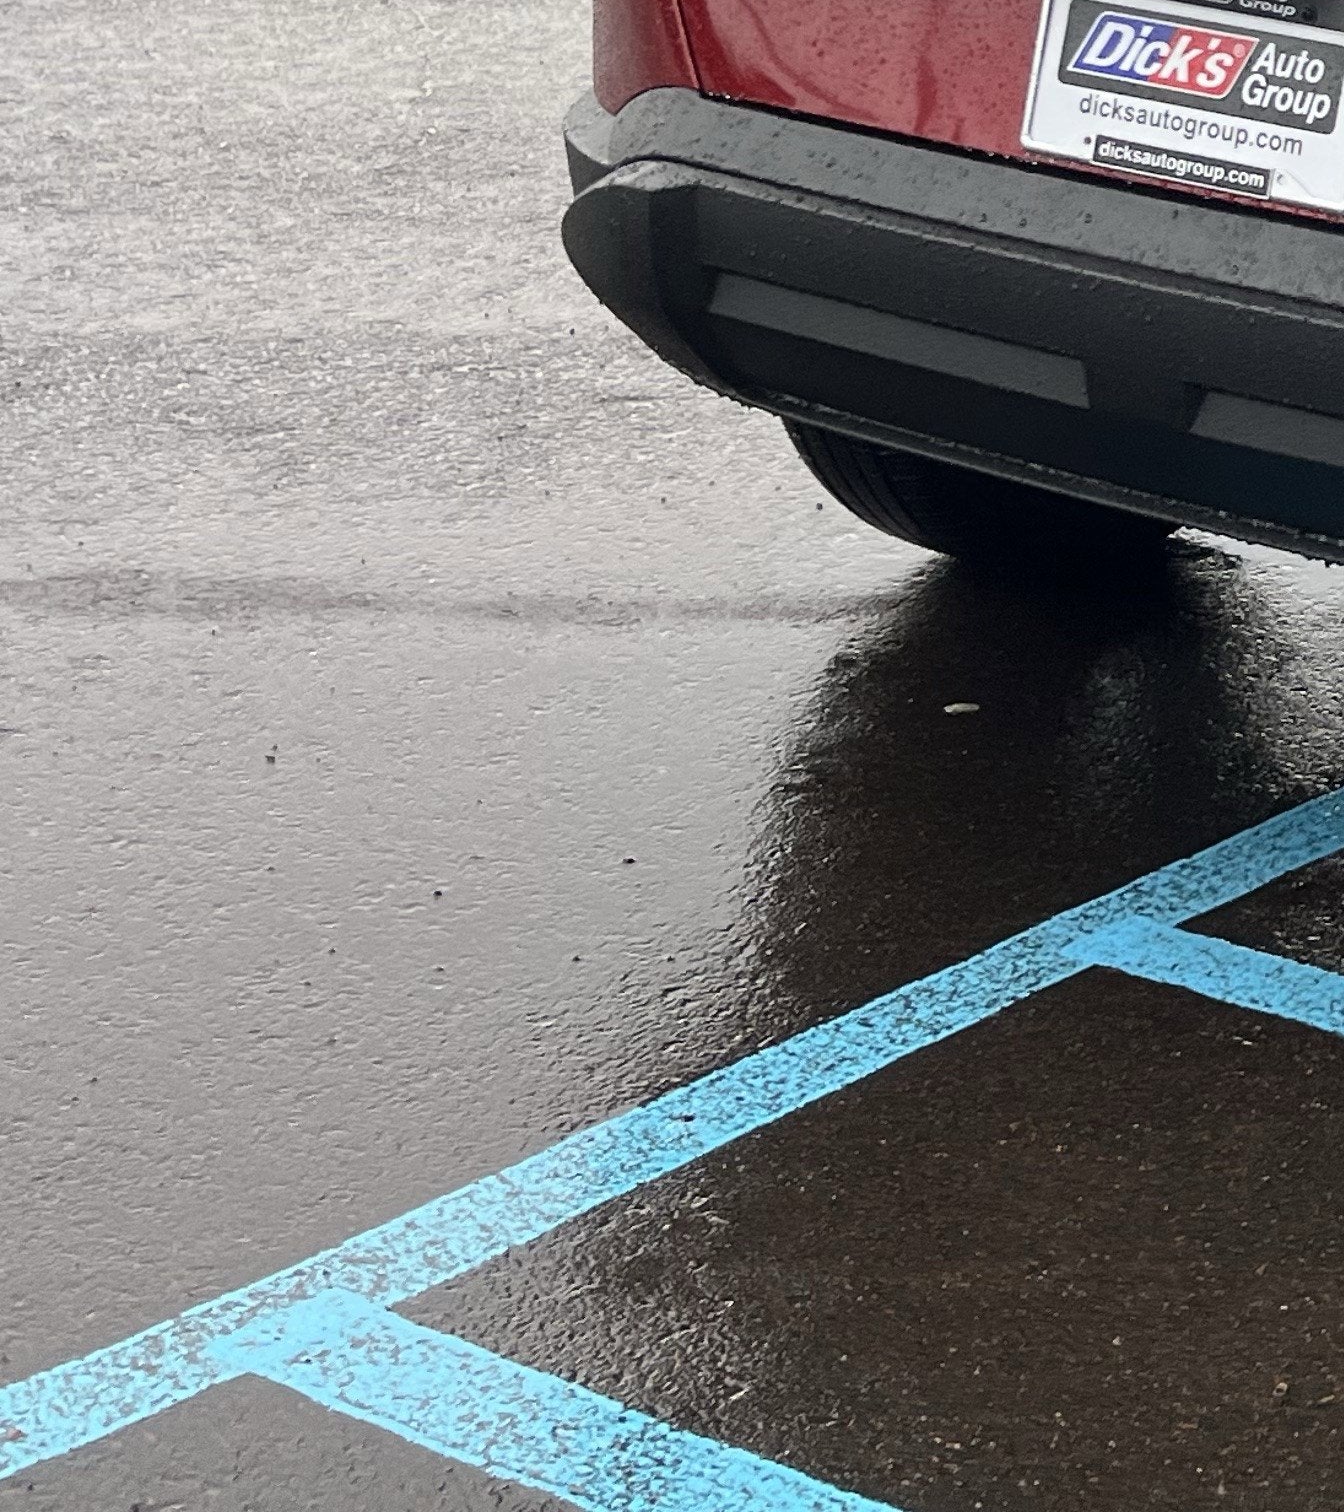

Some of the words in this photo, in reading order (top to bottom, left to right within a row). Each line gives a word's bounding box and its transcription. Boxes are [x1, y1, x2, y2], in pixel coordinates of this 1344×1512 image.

[1082, 21, 1235, 88] Dick's
[1251, 42, 1325, 83] Auto
[1242, 73, 1331, 124] Group
[1079, 93, 1303, 156] dicksautogroup.com
[1098, 141, 1265, 189] dicksautogroup.com
